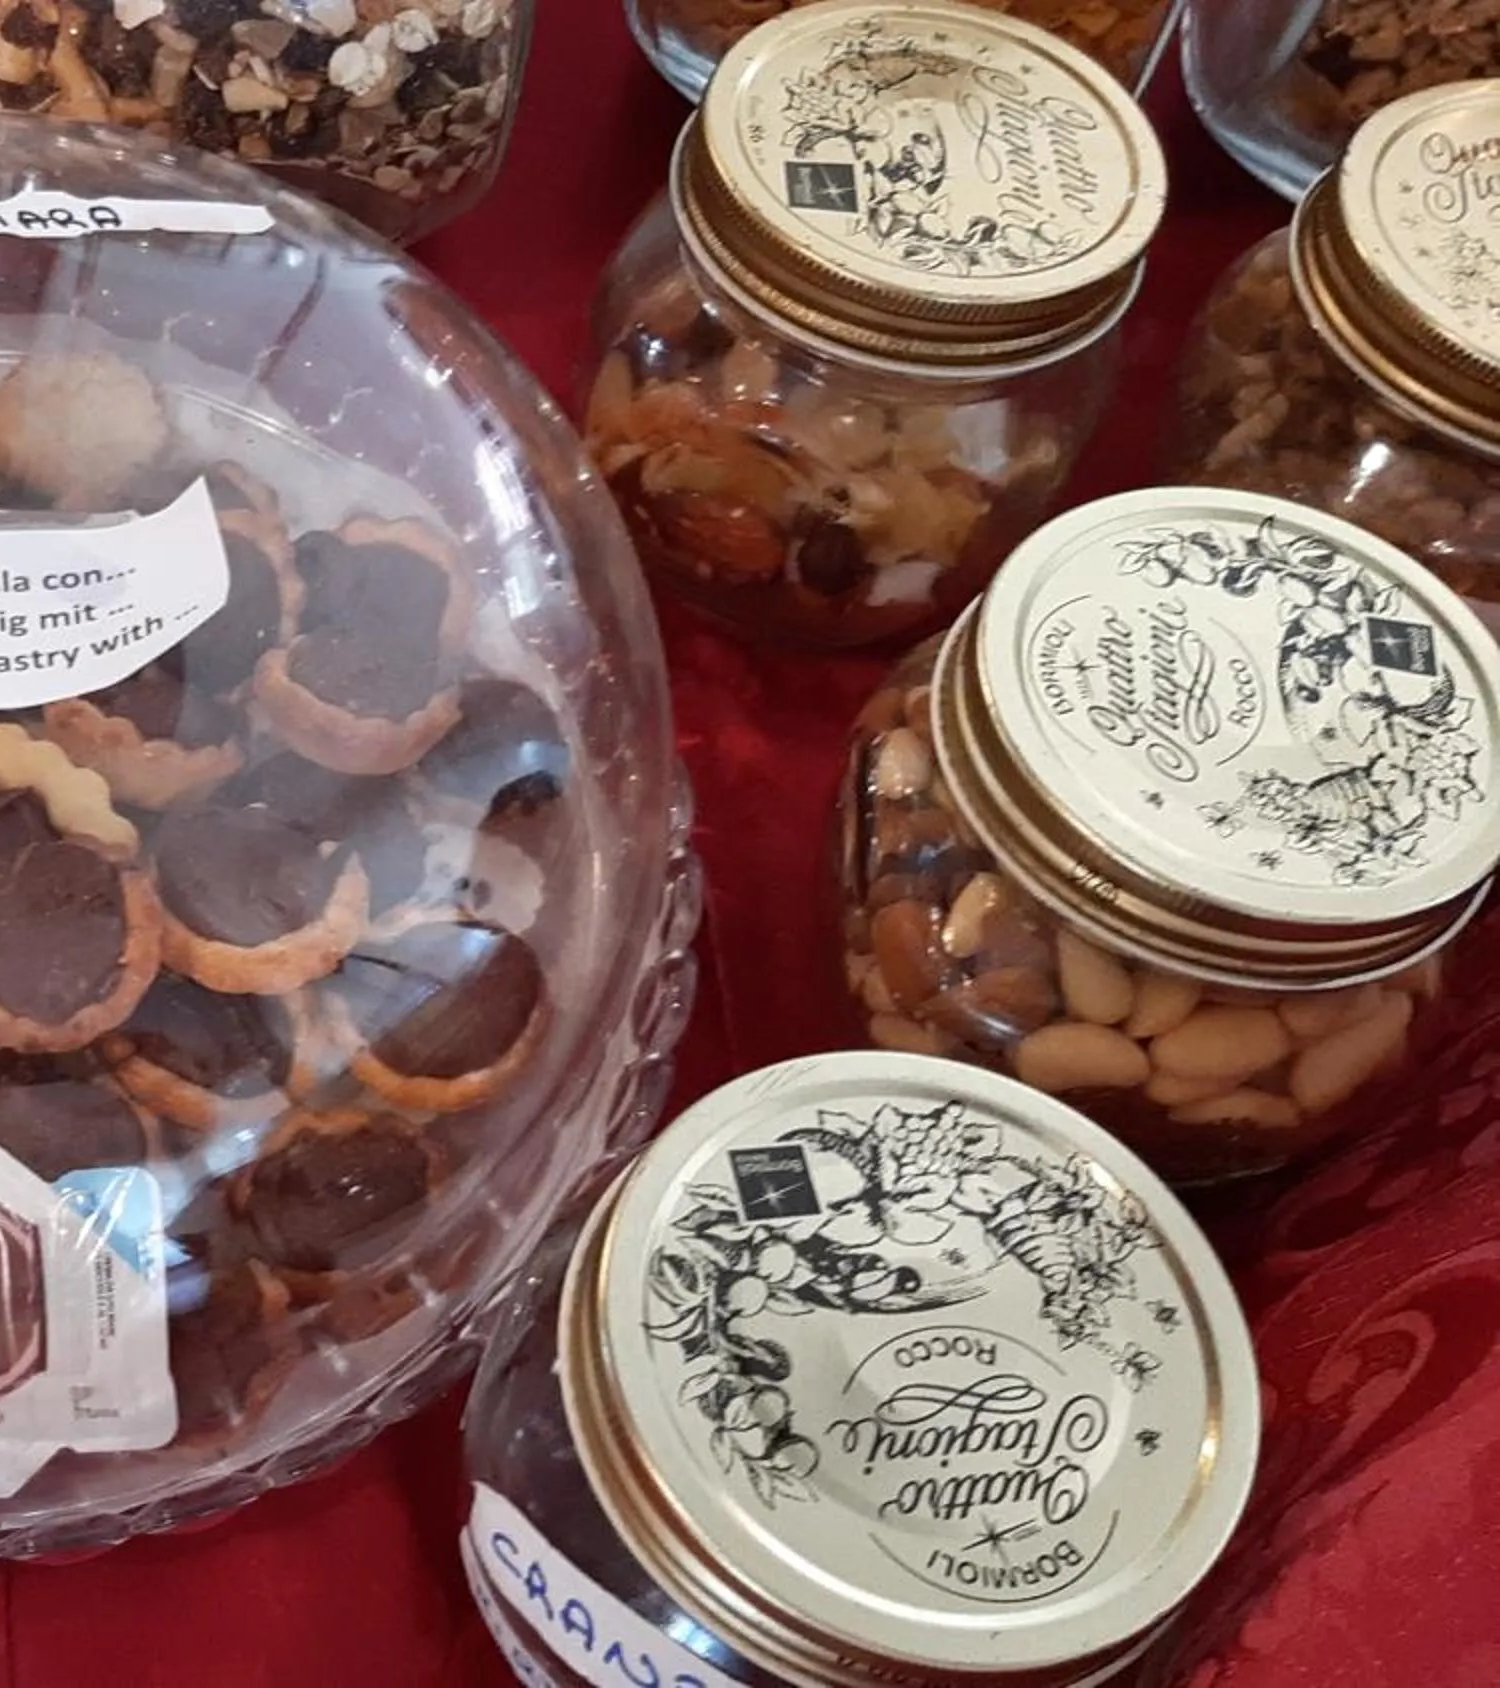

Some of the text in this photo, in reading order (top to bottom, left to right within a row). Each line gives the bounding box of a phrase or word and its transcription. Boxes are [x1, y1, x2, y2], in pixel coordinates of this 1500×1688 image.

[1033, 97, 1100, 225] Quattro
[39, 603, 98, 631] mit
[88, 615, 164, 656] with
[1038, 619, 1077, 717] BORMIOLI
[1086, 604, 1147, 747] Quattro
[1226, 658, 1258, 729] ROCCO
[895, 1334, 999, 1369] ROCCO
[878, 1455, 1090, 1525] Quattro
[926, 1539, 1085, 1588] BORMIOLI
